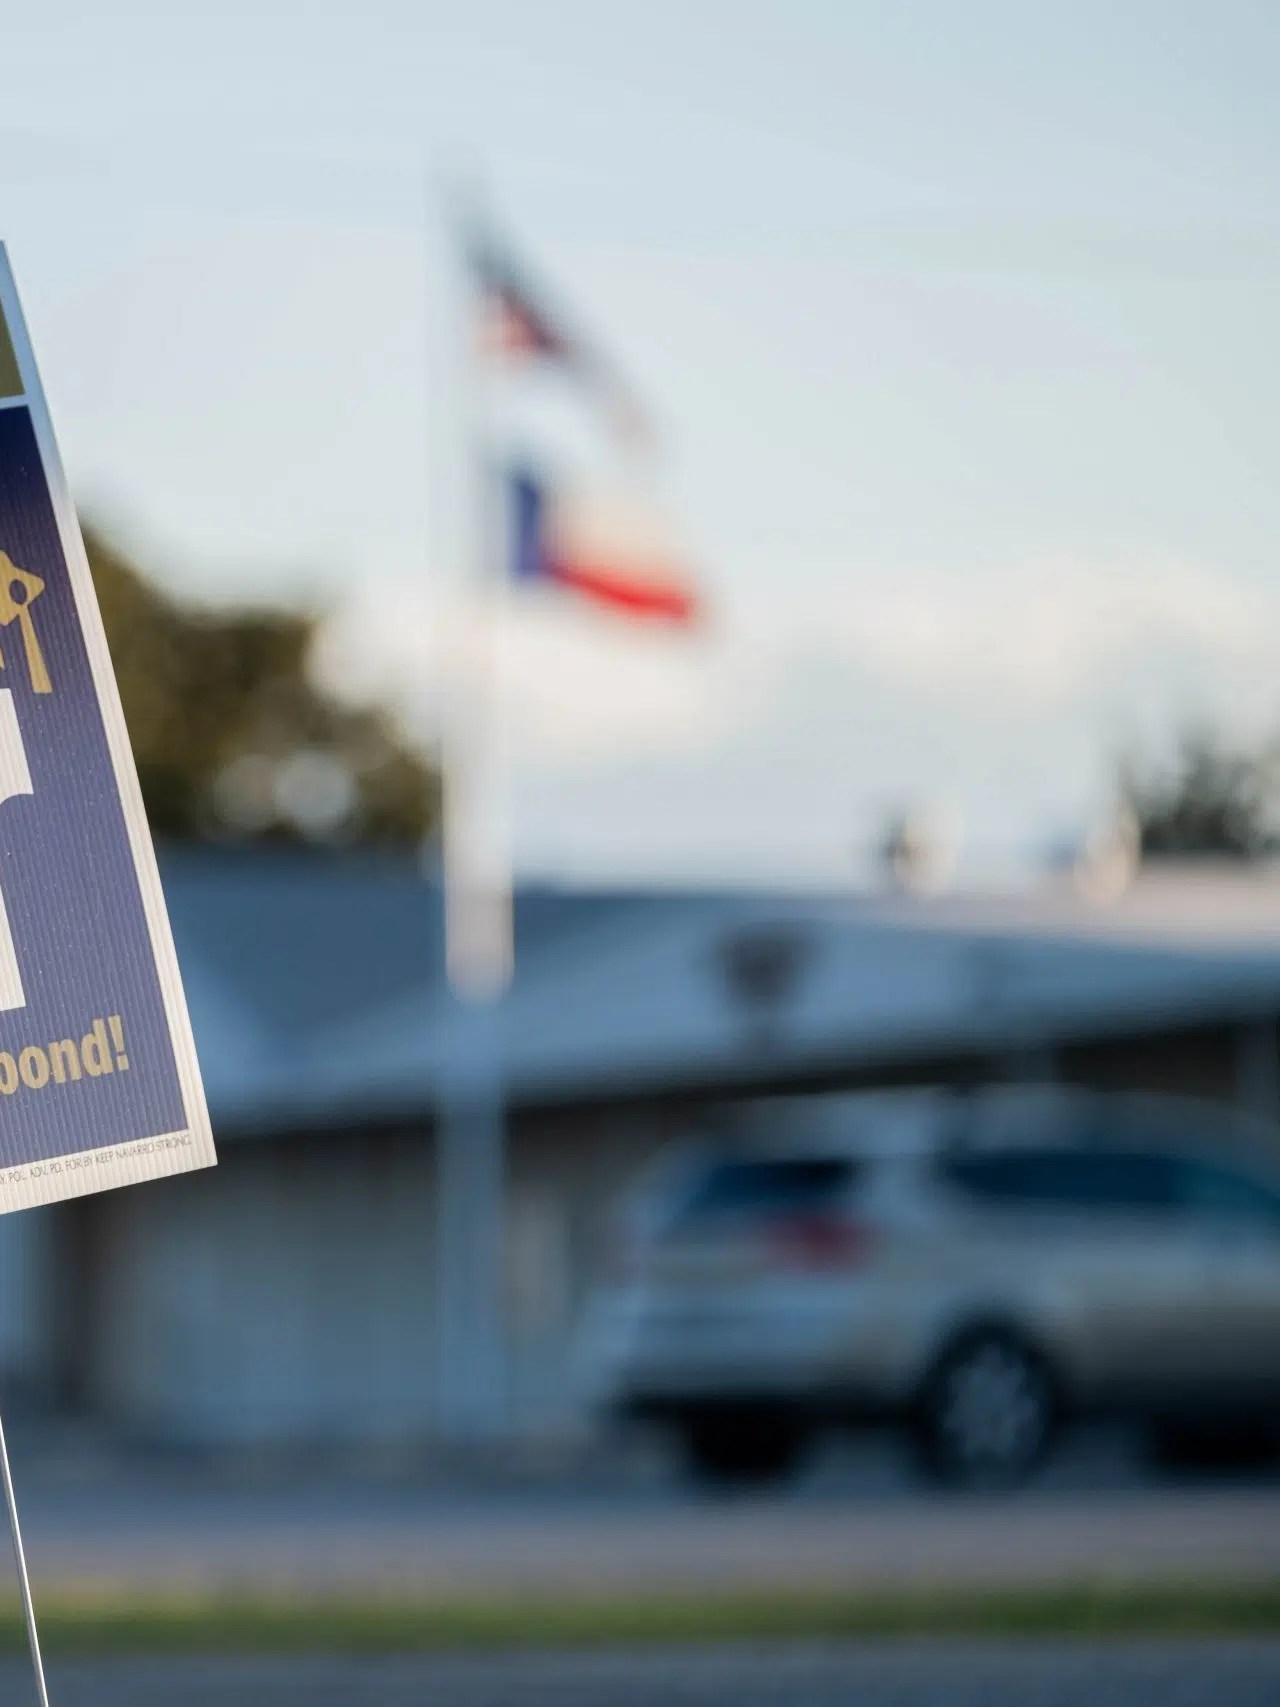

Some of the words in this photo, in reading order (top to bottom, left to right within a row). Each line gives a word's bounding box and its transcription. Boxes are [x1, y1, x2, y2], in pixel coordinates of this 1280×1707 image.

[64, 1157, 83, 1170] FOR
[83, 1155, 93, 1166] BY
[94, 1150, 115, 1164] KEEP
